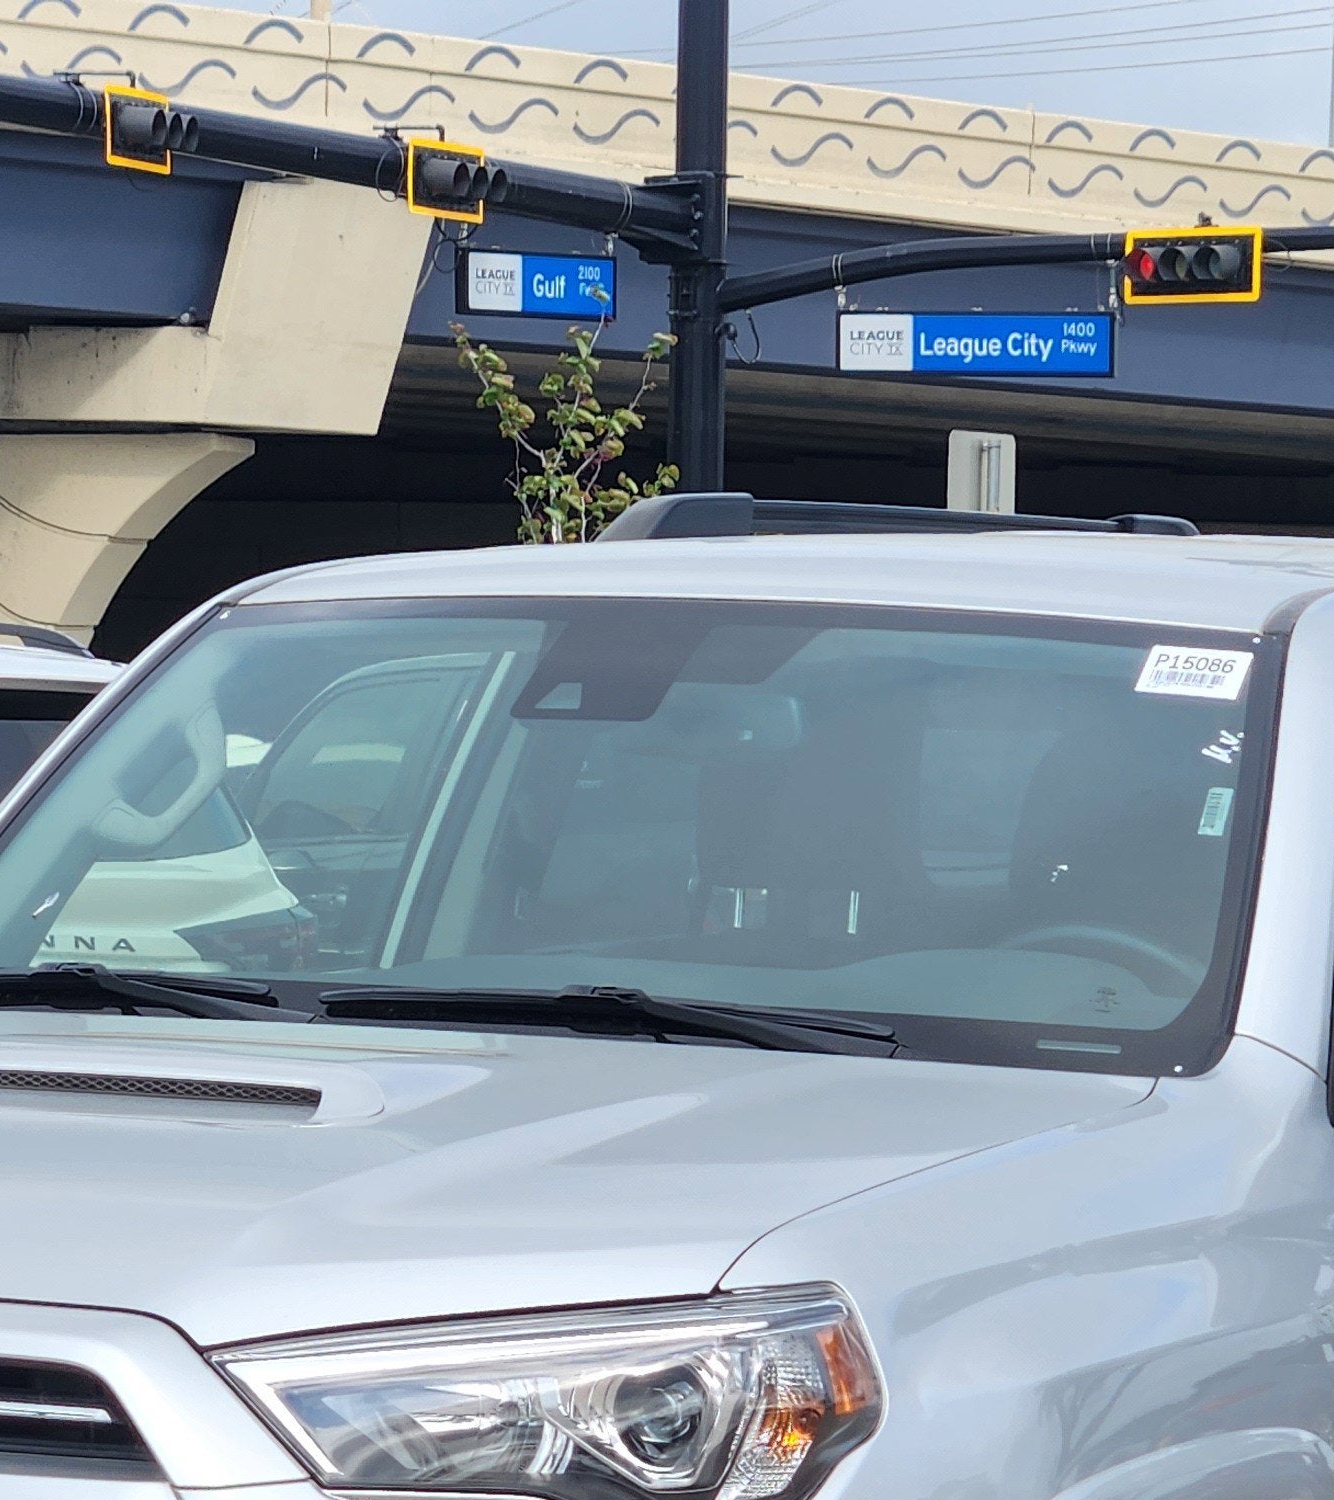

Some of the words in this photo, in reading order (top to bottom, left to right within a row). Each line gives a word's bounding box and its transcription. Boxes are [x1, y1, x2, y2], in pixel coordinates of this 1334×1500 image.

[475, 267, 516, 281] LEAGUE
[578, 264, 601, 281] 2100
[475, 281, 500, 296] CITY
[532, 272, 566, 299] Gulf
[849, 330, 904, 341] LEAGUE
[1062, 322, 1096, 338] 1400
[849, 343, 883, 356] CITY
[919, 332, 1002, 364] League
[1006, 332, 1054, 362] City
[1060, 339, 1098, 356] Pkwy
[1154, 653, 1237, 674] P15086
